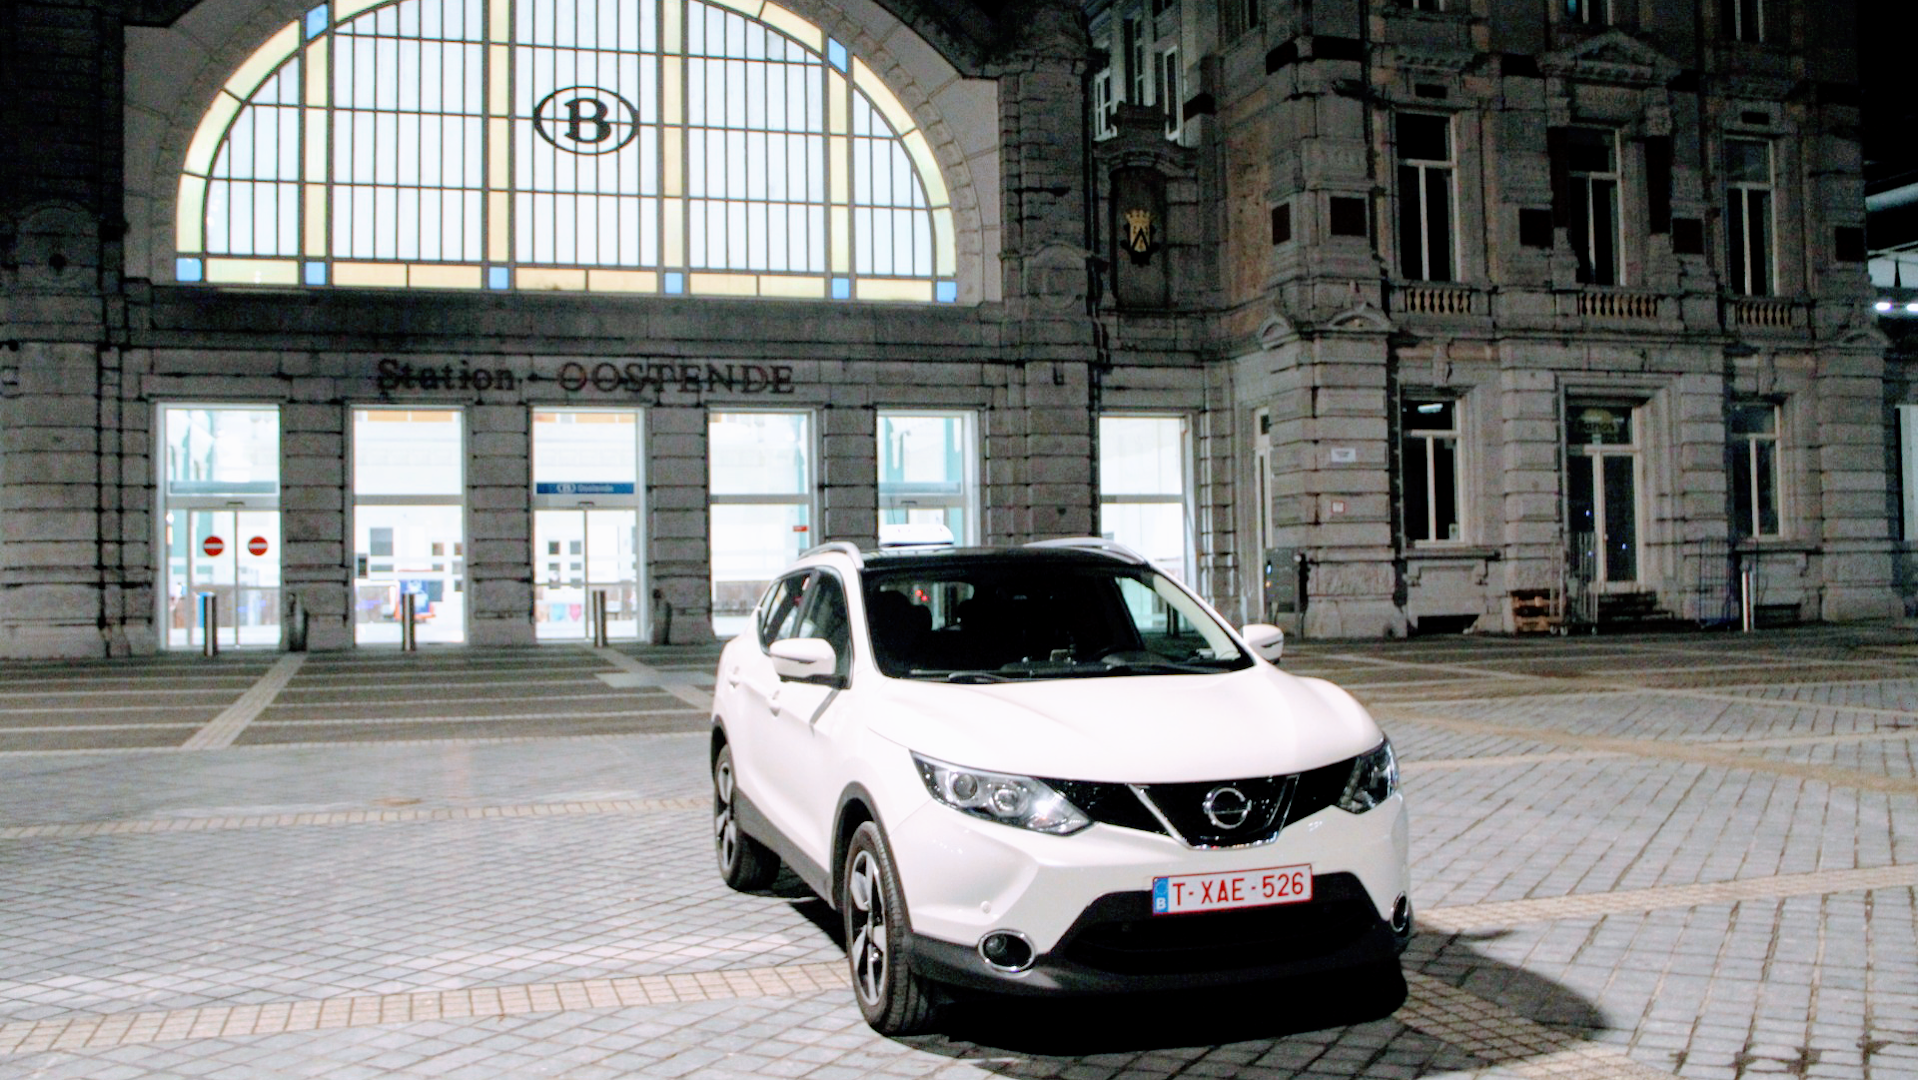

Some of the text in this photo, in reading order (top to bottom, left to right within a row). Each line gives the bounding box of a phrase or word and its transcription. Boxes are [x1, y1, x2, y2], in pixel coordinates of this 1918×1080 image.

[563, 97, 611, 143] B
[377, 358, 795, 395] Station OOSTENDE
[1156, 897, 1167, 910] B
[1172, 872, 1304, 906] T-XAE-526
